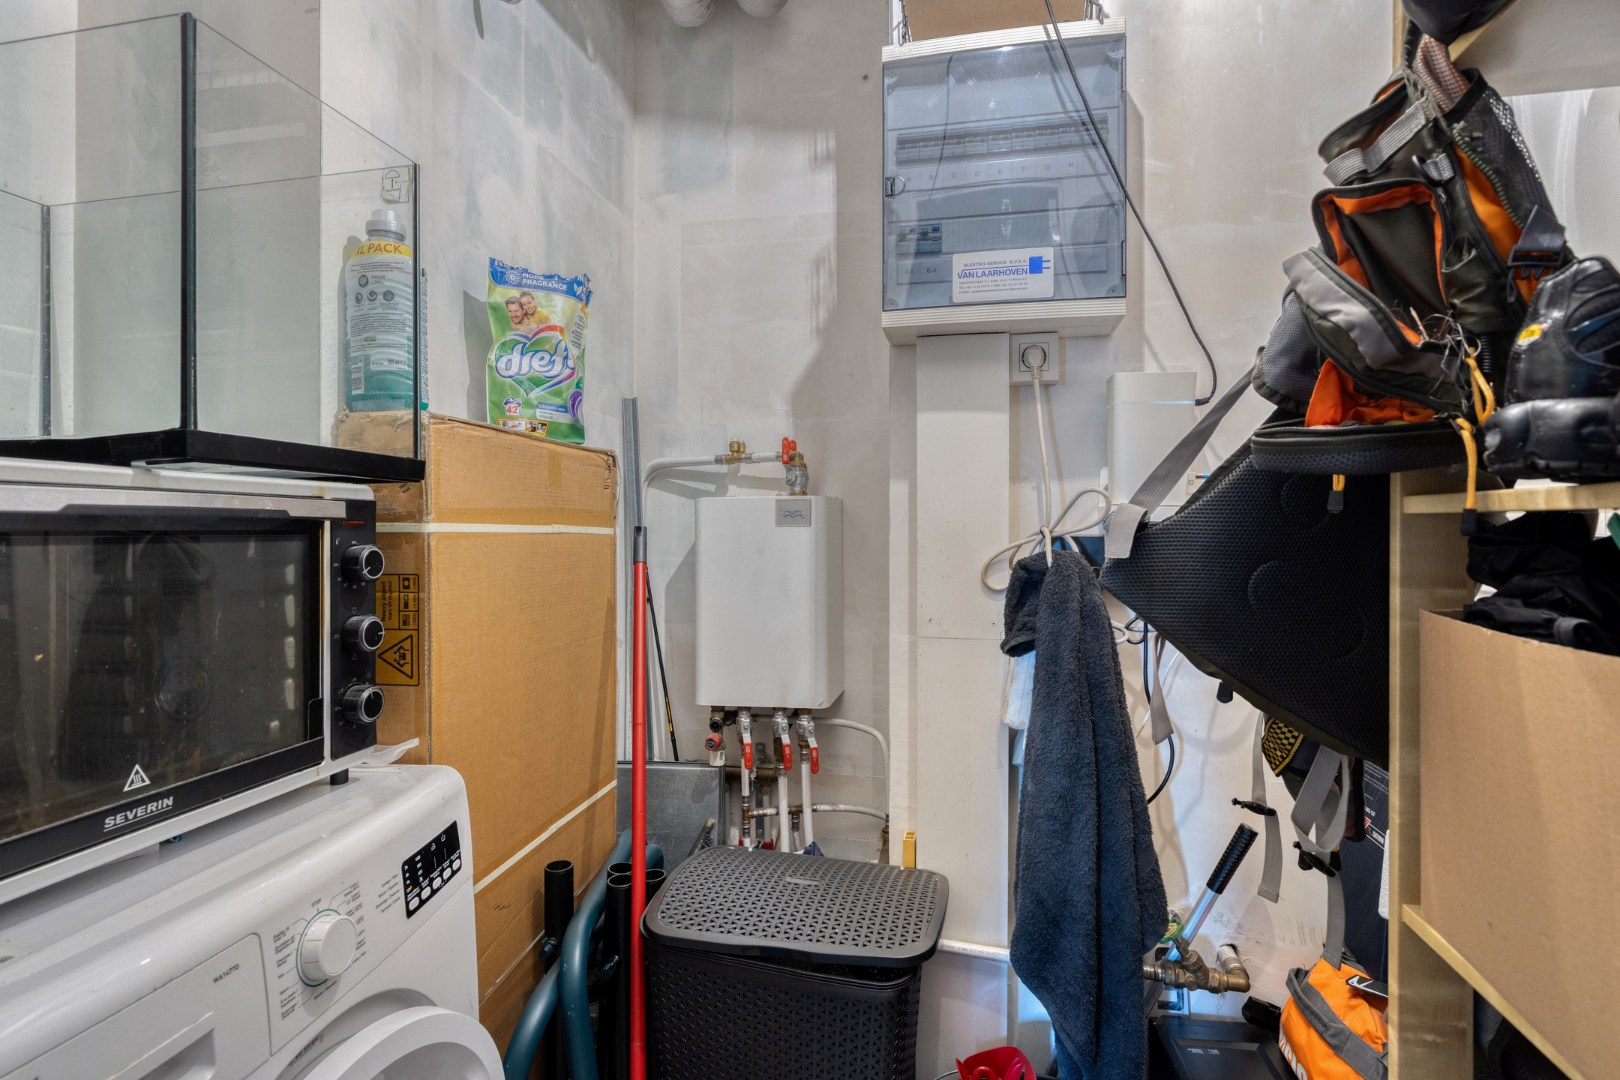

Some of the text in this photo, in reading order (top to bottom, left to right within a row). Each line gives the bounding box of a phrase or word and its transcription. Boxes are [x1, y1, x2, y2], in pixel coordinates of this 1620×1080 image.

[368, 243, 402, 254] PACK
[958, 268, 1028, 279] VAN LAARHOVEN
[522, 278, 567, 290] FRAGRANCE
[506, 404, 518, 414] 42
[104, 796, 174, 828] SEVERIN
